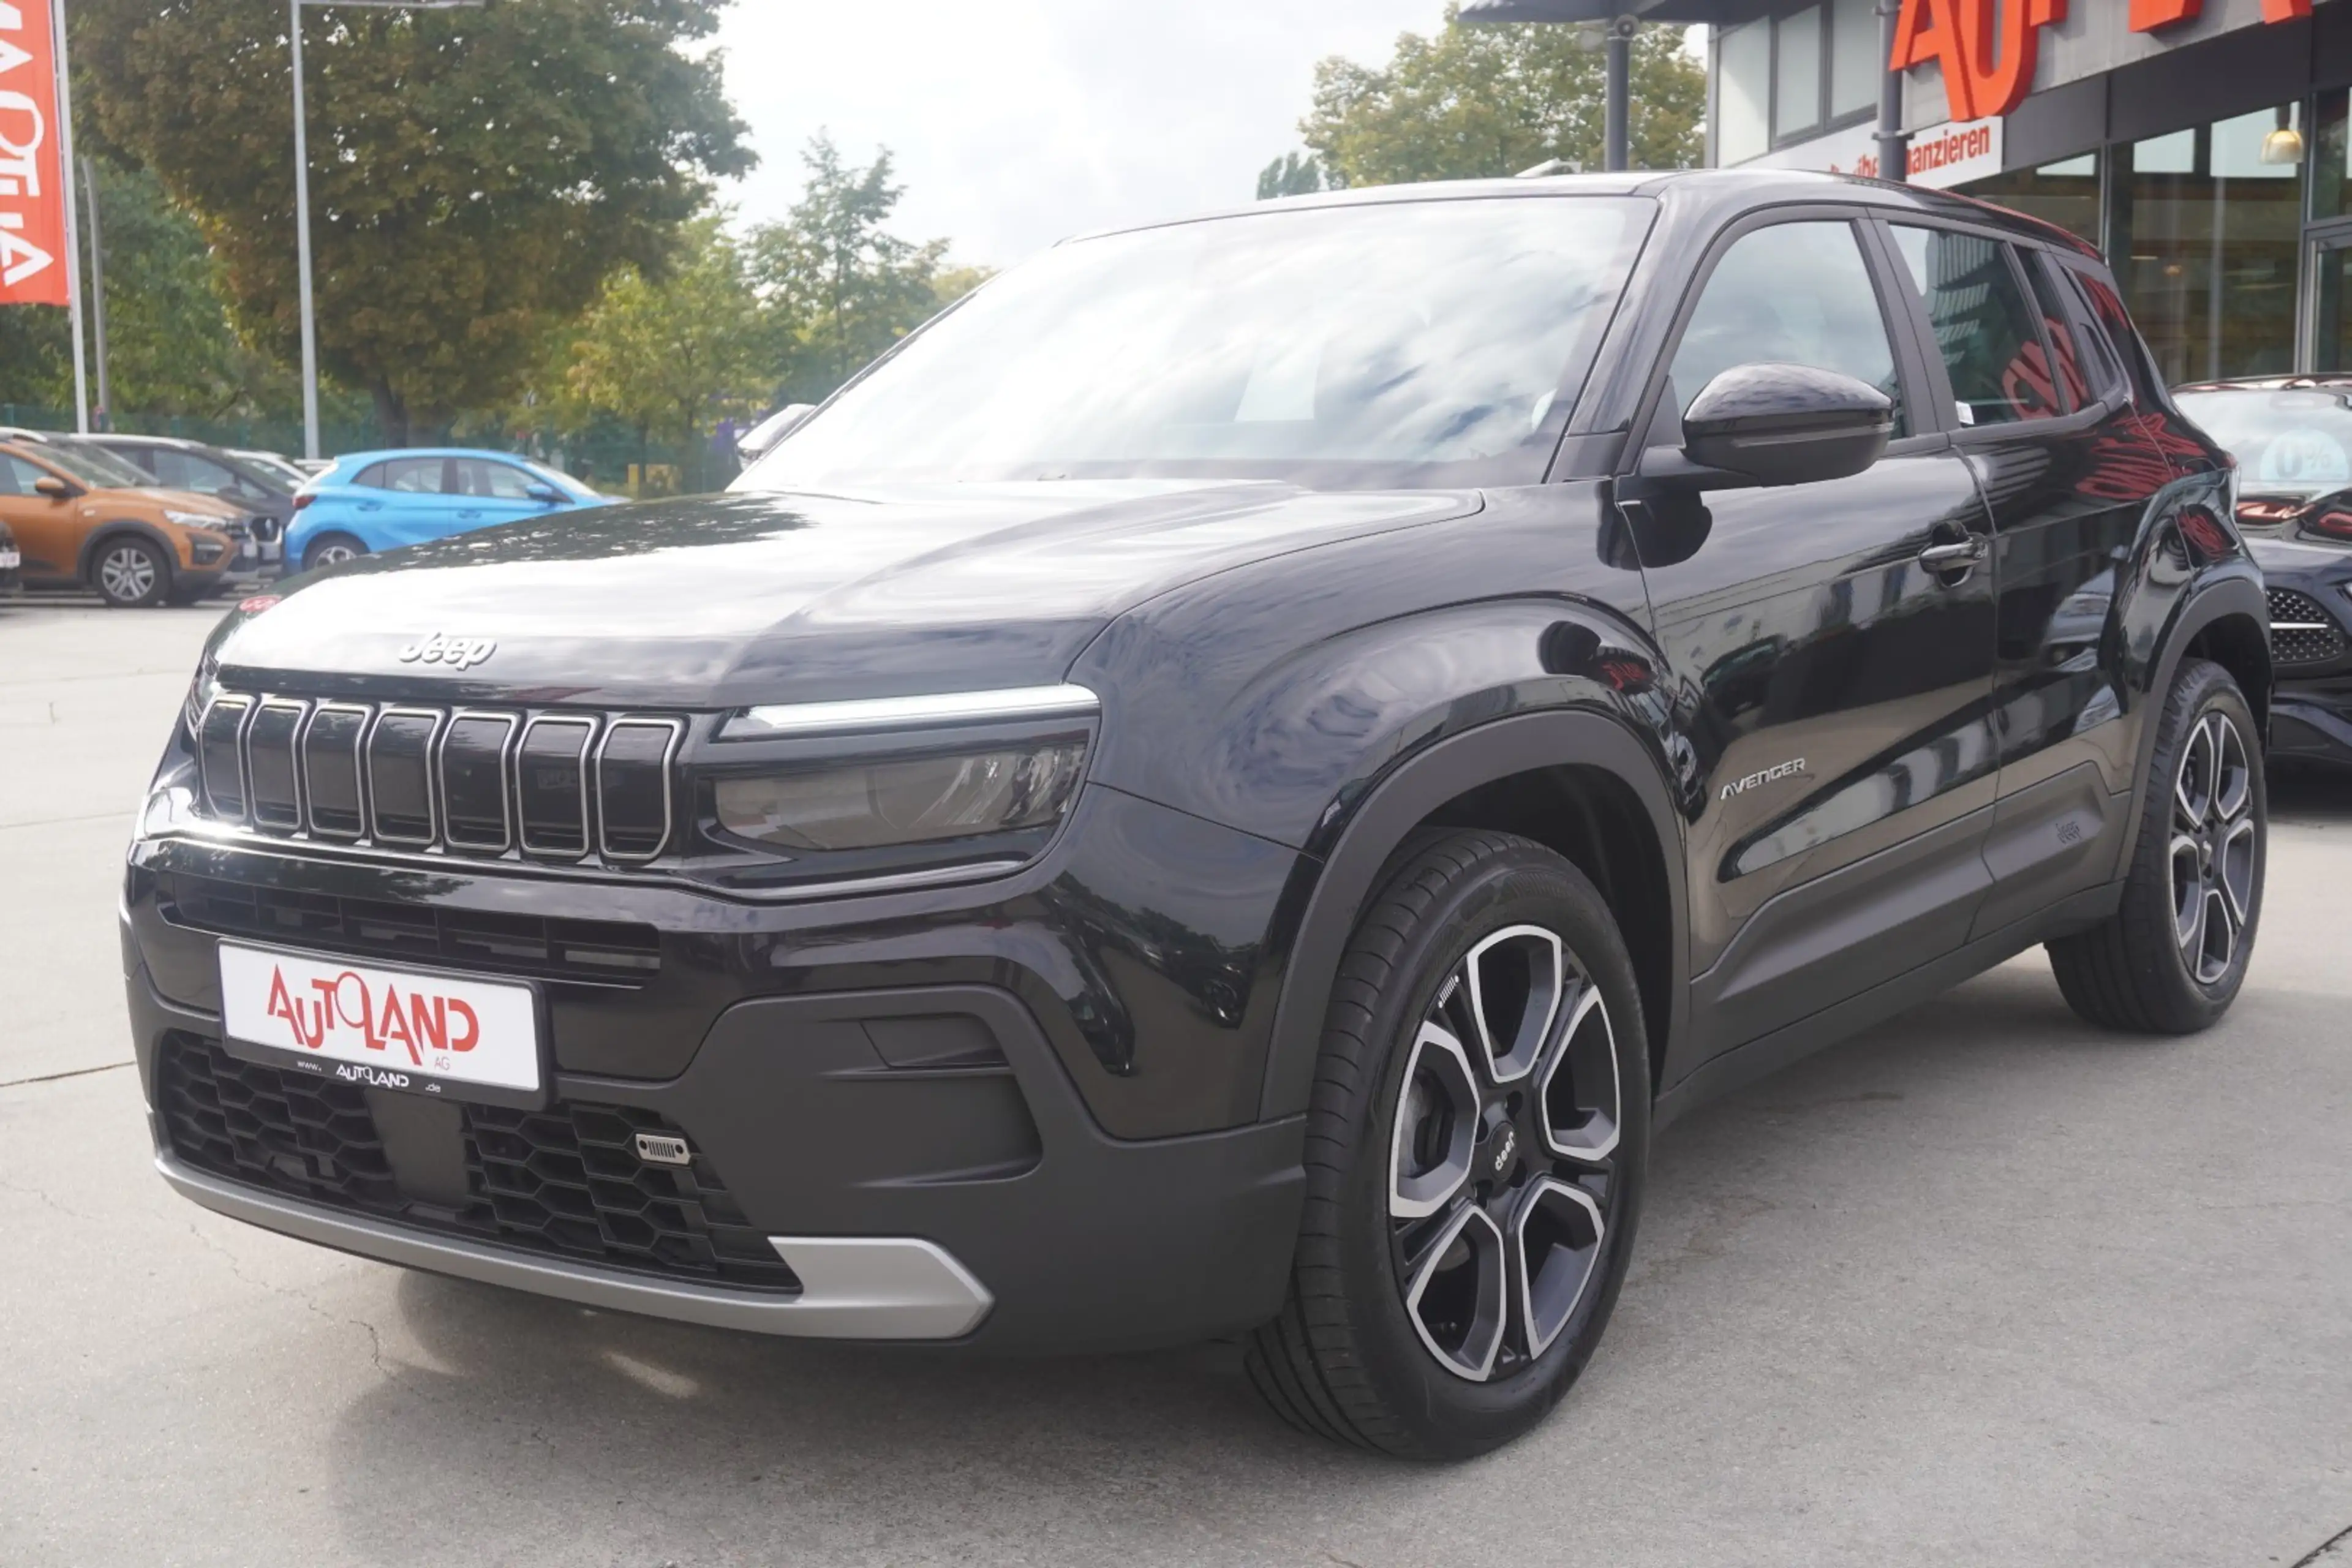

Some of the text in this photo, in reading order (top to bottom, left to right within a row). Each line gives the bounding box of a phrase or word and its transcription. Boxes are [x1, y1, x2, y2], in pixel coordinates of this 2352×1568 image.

[399, 632, 497, 671] Jeep
[1720, 757, 1806, 801] AVENGER
[267, 963, 480, 1066] AUTOLAND
[336, 1063, 409, 1088] AUTOLAND
[434, 1056, 451, 1071] AG
[1494, 1130, 1515, 1172] Jeep
